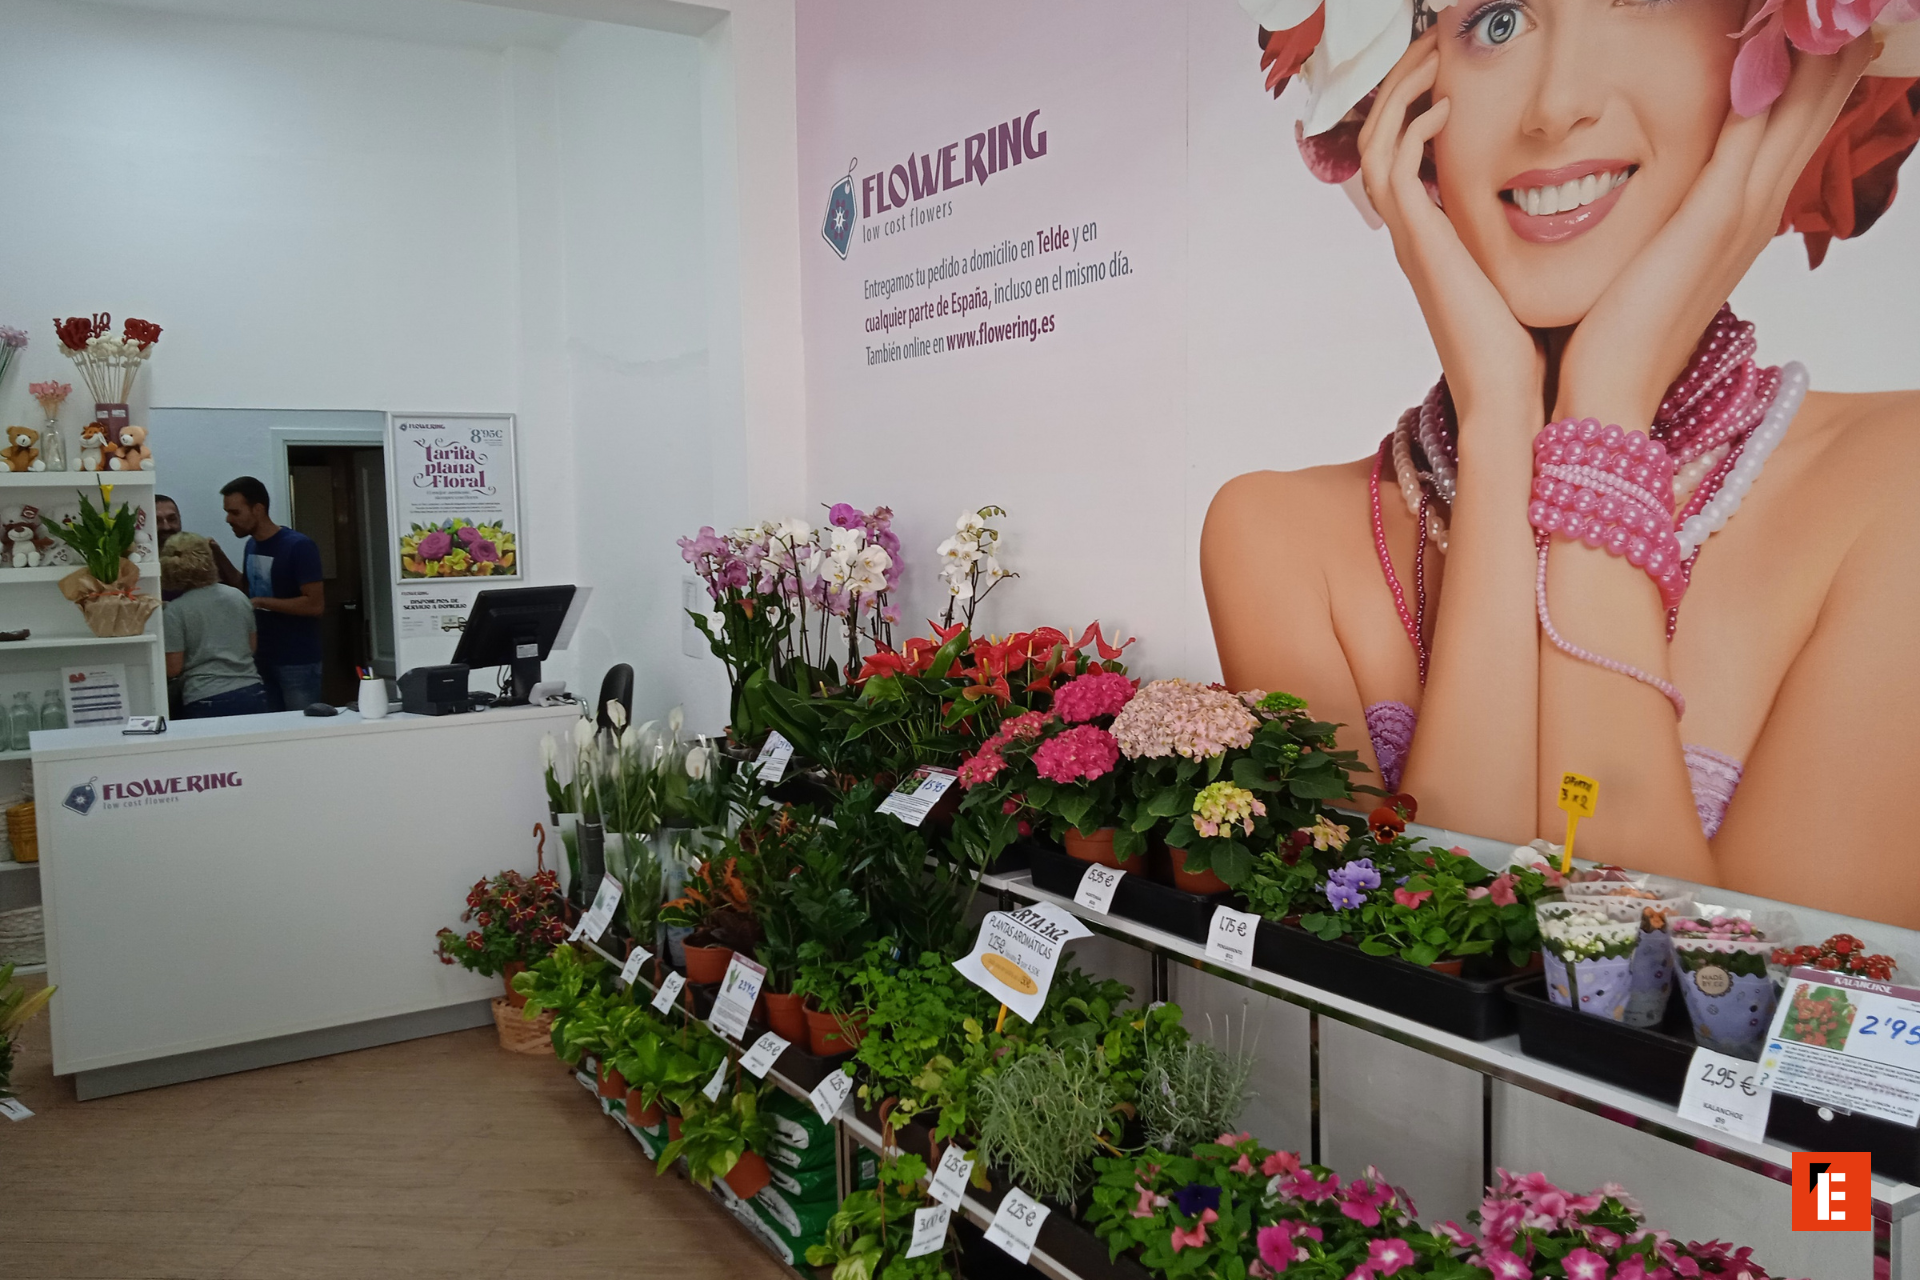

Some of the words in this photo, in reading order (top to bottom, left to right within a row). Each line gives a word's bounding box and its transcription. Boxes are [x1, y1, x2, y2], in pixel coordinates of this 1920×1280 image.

[862, 109, 1048, 218] FLOWERING
[863, 225, 880, 243] low
[885, 214, 906, 236] cost
[910, 201, 953, 228] flowers
[864, 272, 914, 300] Entregamos
[916, 268, 925, 286] tu
[928, 255, 960, 289] pedido
[962, 258, 968, 274] a
[970, 240, 1018, 273] domicilio
[1020, 239, 1034, 259] en
[1037, 224, 1070, 254] Telde
[1072, 226, 1079, 252] y
[1082, 222, 1097, 242] en
[865, 307, 907, 334] cualquier
[908, 303, 934, 329] parte
[936, 295, 949, 317] de
[951, 286, 992, 318] España,
[994, 278, 1032, 305] incluso
[1035, 275, 1049, 295] en
[1052, 265, 1062, 291] el
[1065, 262, 1106, 289] mismo
[1109, 250, 1133, 278] día.
[866, 341, 901, 366] También
[903, 336, 931, 359] online
[932, 336, 944, 354] en
[946, 314, 1055, 351] www.flowering.es
[102, 771, 242, 800] FLOWERING
[103, 802, 119, 810] low
[123, 799, 142, 808] cost
[145, 796, 179, 805] flowers
[989, 915, 1015, 937] PLANTAS
[1834, 976, 1893, 994] KALANCHOE
[1701, 1063, 1738, 1089] 2,95
[1740, 1076, 1757, 1097] €
[1703, 1102, 1744, 1120] KALANCHOE
